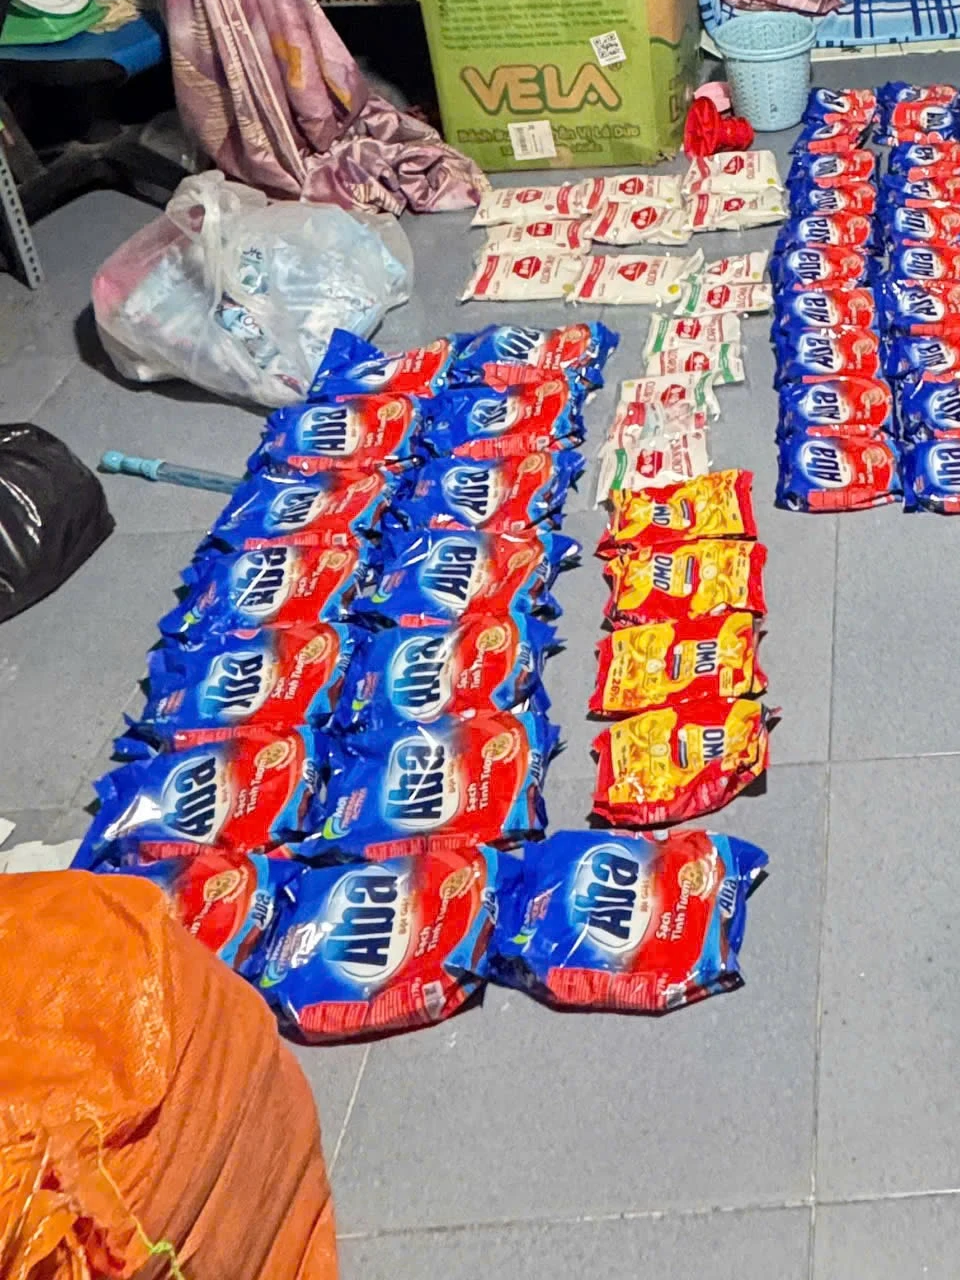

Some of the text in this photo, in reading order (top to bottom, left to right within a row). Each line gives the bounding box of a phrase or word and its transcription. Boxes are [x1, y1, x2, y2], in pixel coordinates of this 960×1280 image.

[460, 62, 622, 115] VELA
[304, 408, 348, 452] Aba
[805, 446, 842, 483] Aba
[422, 545, 478, 601] Aba
[652, 555, 673, 591] OMO
[694, 641, 717, 675] OMO
[703, 728, 725, 765] OM
[163, 756, 218, 837] Aba
[385, 745, 445, 820] Aba
[575, 852, 640, 940] Aba
[722, 877, 738, 913] Aba
[325, 875, 399, 967] Aba
[656, 911, 672, 941] Sạch
[670, 911, 686, 942] Tinh
